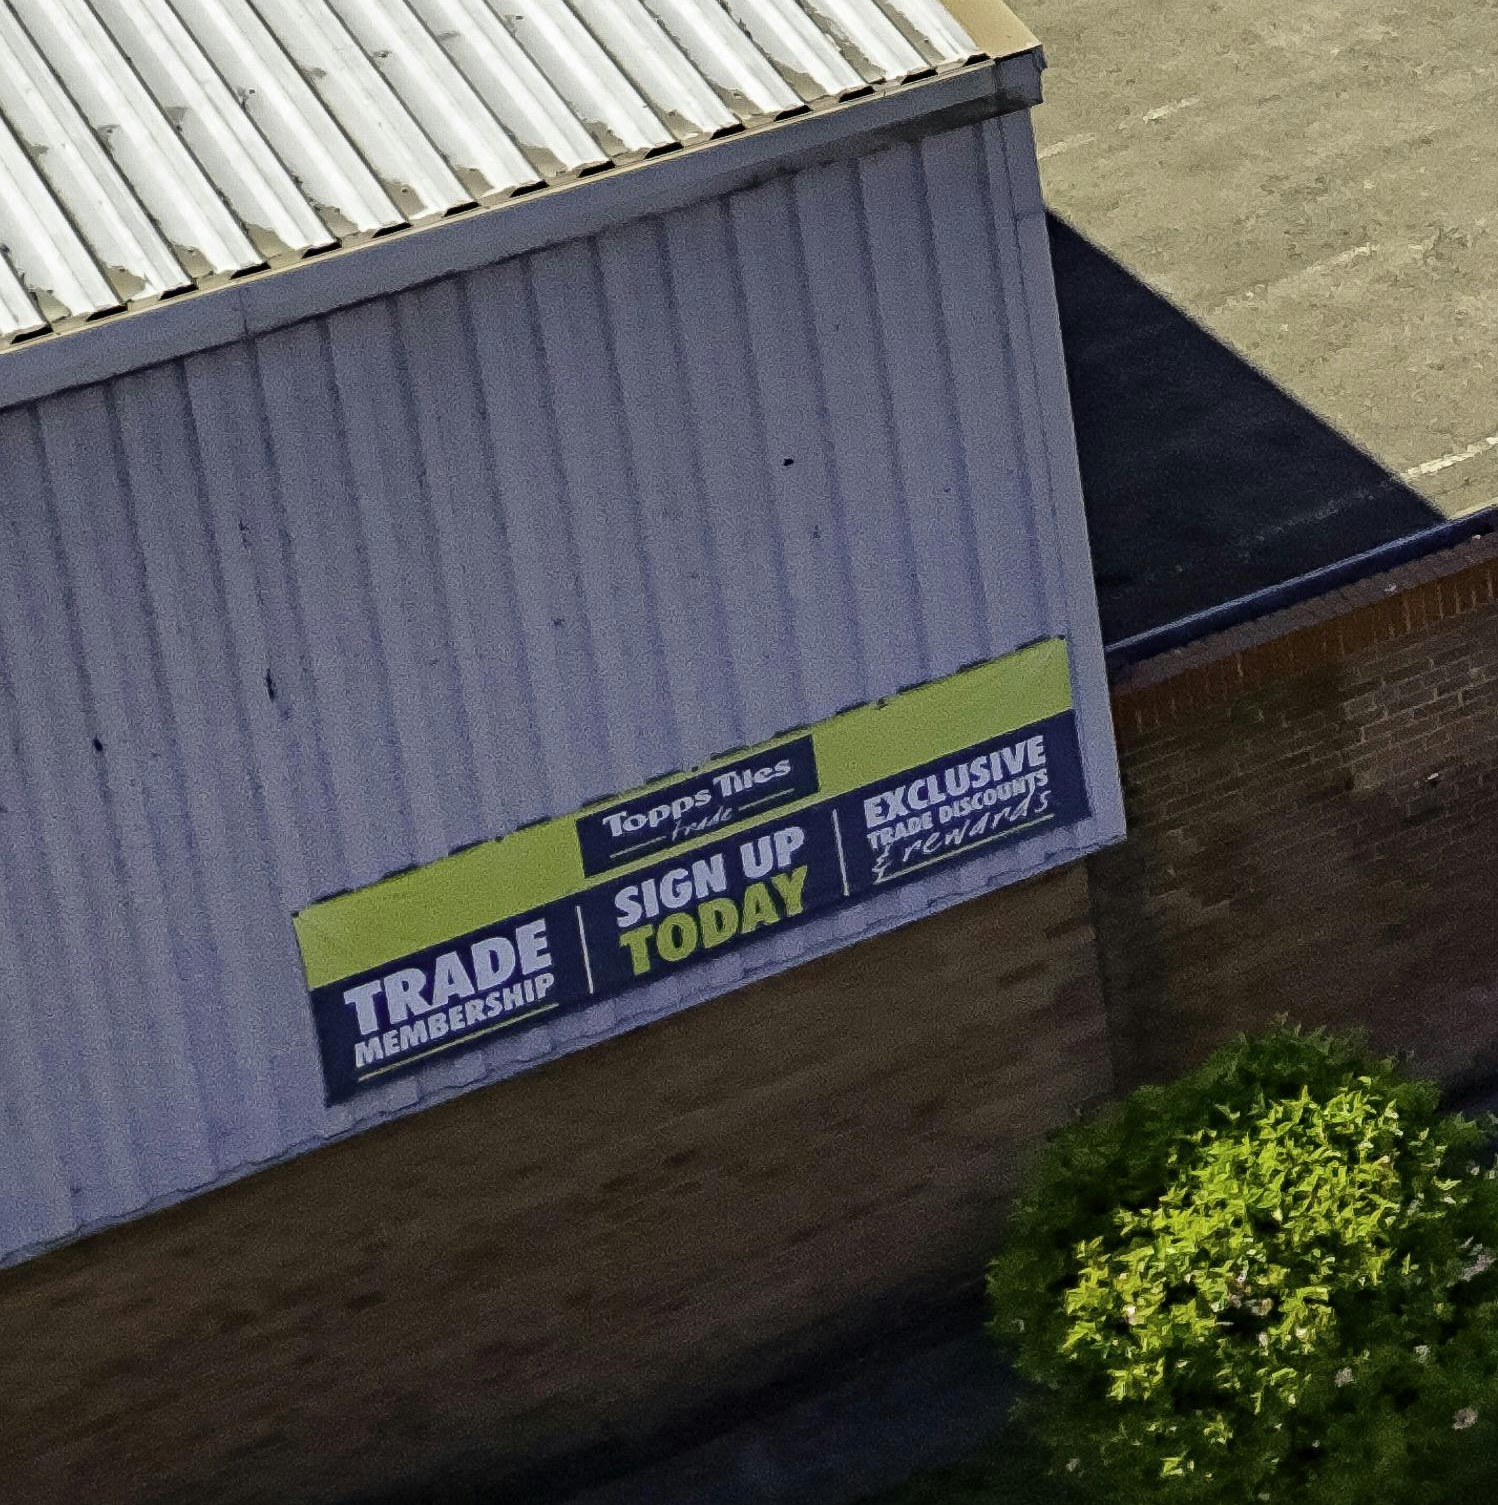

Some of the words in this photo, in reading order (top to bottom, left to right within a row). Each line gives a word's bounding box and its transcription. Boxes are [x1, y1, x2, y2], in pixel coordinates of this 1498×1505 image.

[602, 789, 712, 837] Topps
[713, 759, 791, 797] Tiles
[672, 805, 733, 841] trade
[864, 735, 1046, 829] EXCLUSIVE
[867, 810, 933, 850] TRADE
[939, 768, 1048, 823] DISCOUNTS
[902, 782, 1052, 862] rewards
[614, 853, 727, 927] SIGN
[740, 826, 805, 878] UP
[618, 865, 808, 976] TODAY
[343, 918, 552, 1035] TRADE
[354, 973, 554, 1068] MEMBERSHIP
